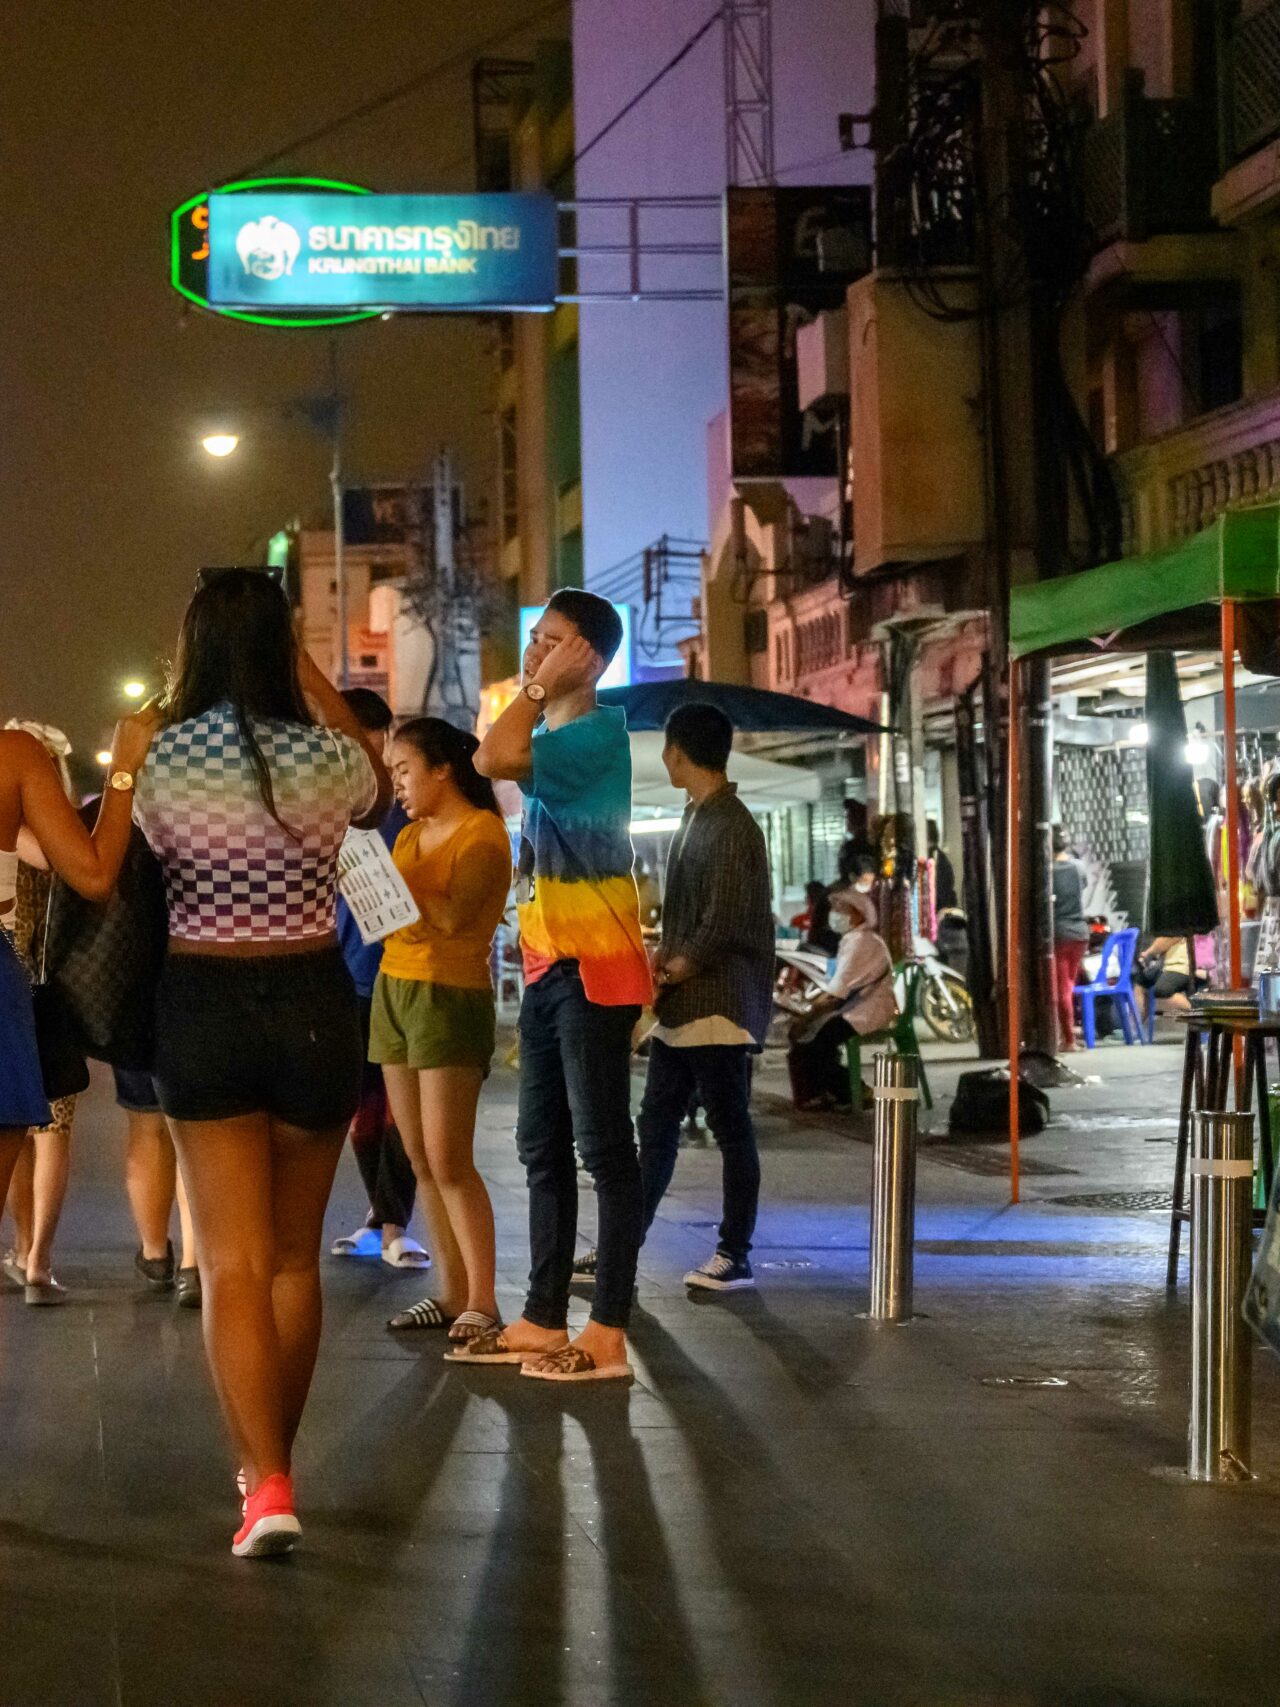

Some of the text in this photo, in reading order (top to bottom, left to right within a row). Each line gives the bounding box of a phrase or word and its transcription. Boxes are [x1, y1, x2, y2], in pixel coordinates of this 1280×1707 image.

[308, 219, 520, 257] ธนาคารกรุงไทย
[308, 258, 478, 275] KRUNGTHAI BANK
